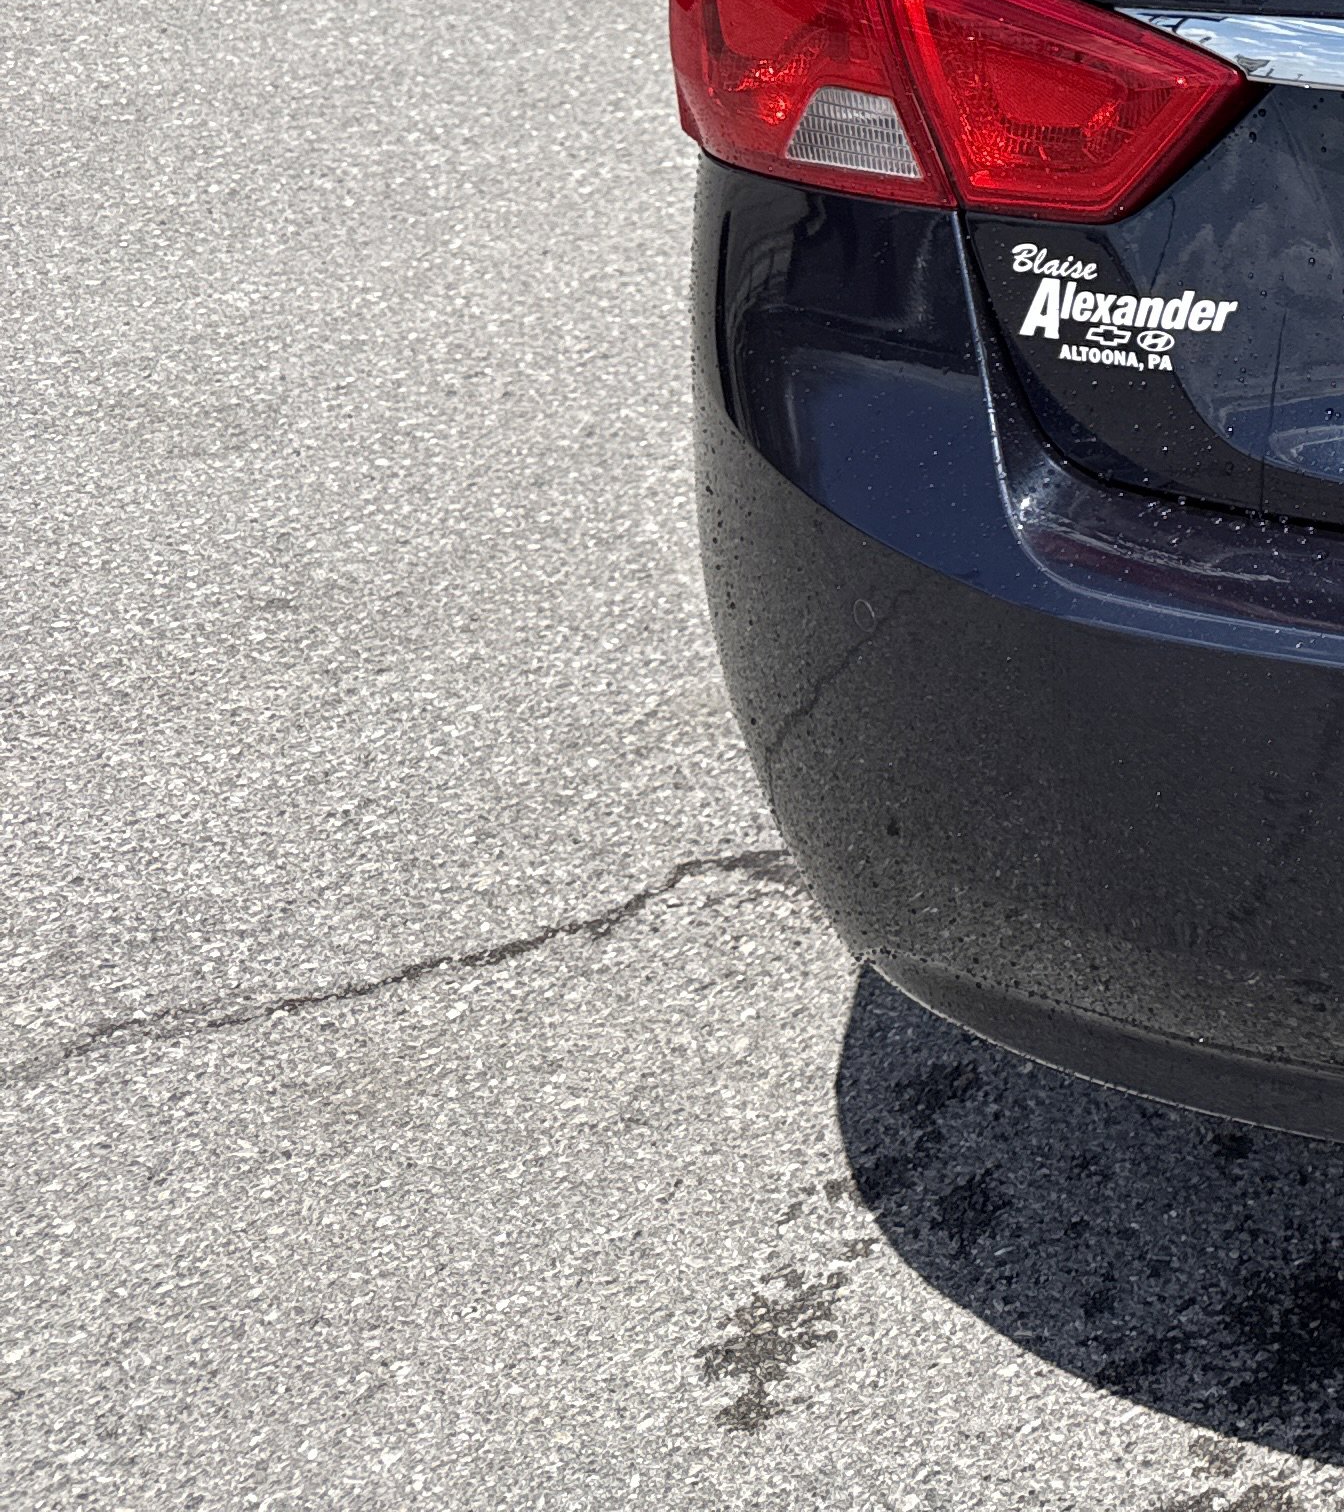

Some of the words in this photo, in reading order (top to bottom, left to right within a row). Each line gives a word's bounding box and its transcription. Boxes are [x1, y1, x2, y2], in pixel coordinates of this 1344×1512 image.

[1012, 243, 1097, 280] Blaise
[1019, 278, 1238, 339] Alexander
[1058, 344, 1145, 372] ALTOONA,
[1147, 353, 1174, 372] PA
